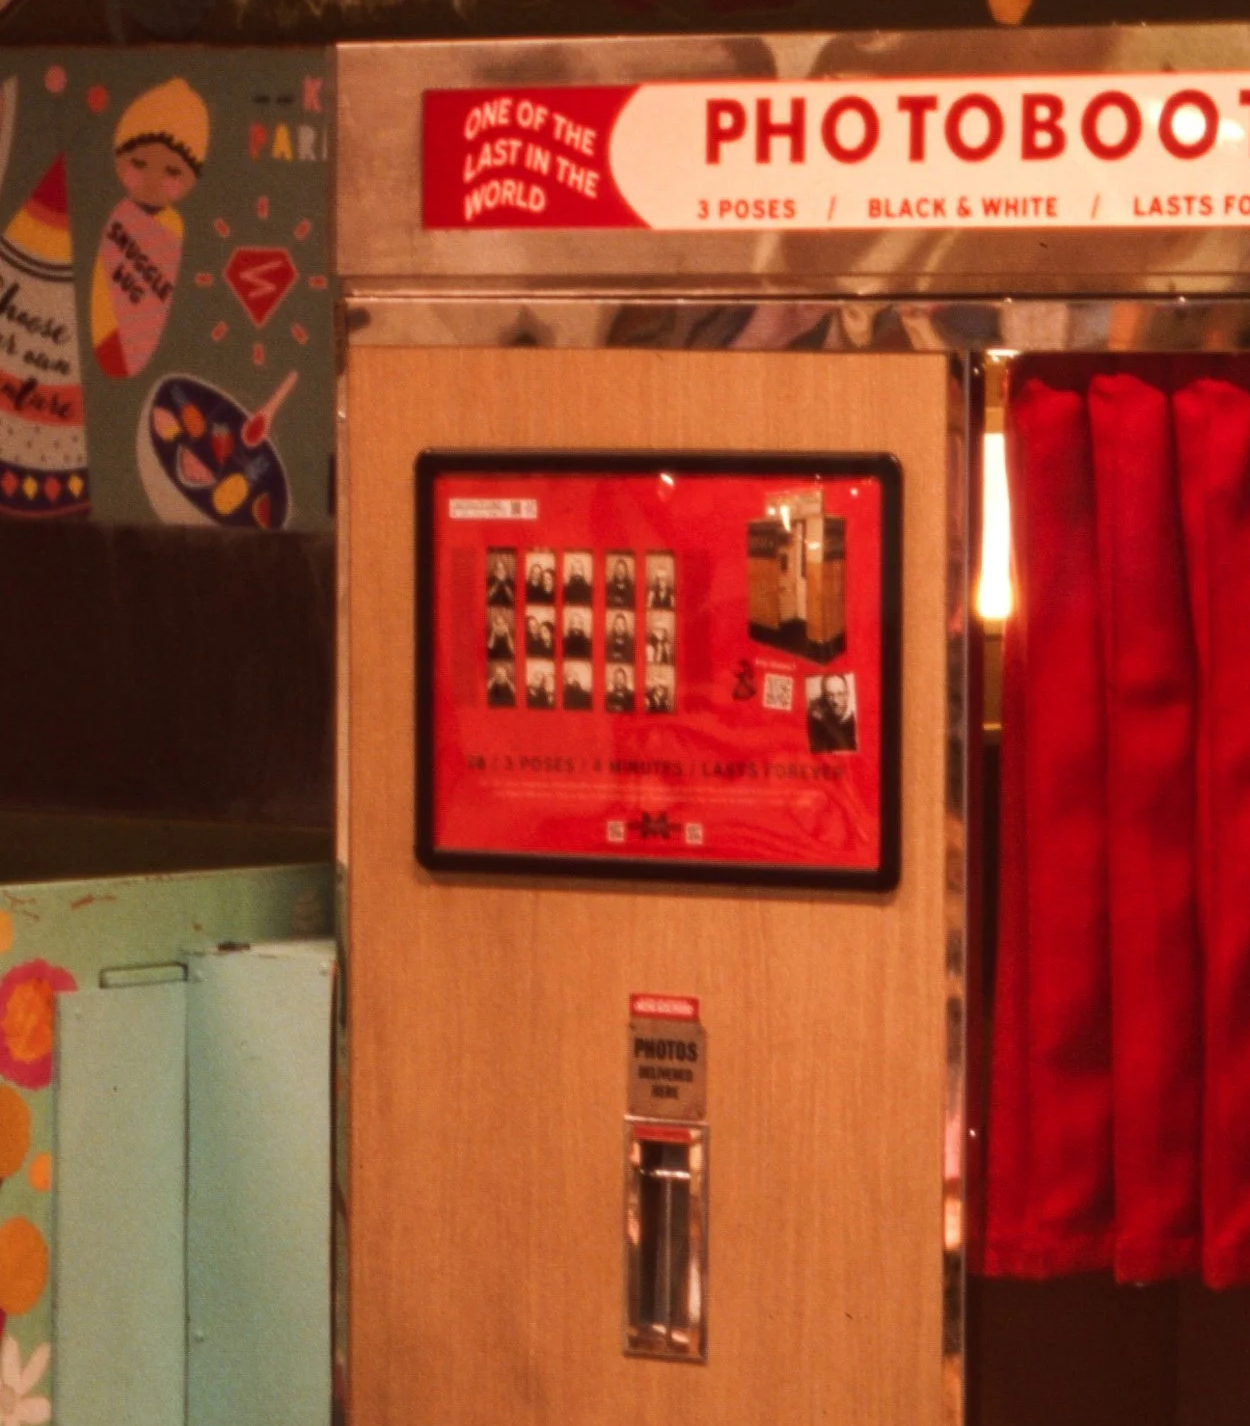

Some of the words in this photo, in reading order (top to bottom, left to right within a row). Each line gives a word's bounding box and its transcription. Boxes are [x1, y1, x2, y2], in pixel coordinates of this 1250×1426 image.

[464, 97, 512, 140] ONE
[517, 99, 548, 131] OF
[552, 112, 597, 156] THE
[464, 138, 522, 183] LAST
[525, 142, 550, 176] IN
[556, 155, 600, 199] THE
[465, 179, 546, 222] WORLD
[697, 199, 709, 219] 3
[718, 198, 796, 219] POSES
[868, 198, 947, 219] BLACK
[957, 196, 971, 218] &
[981, 196, 1058, 218] WHITE
[1133, 195, 1213, 217] LASTS
[107, 221, 173, 303] SNUGGLE
[634, 1036, 698, 1063] PHOTOS
